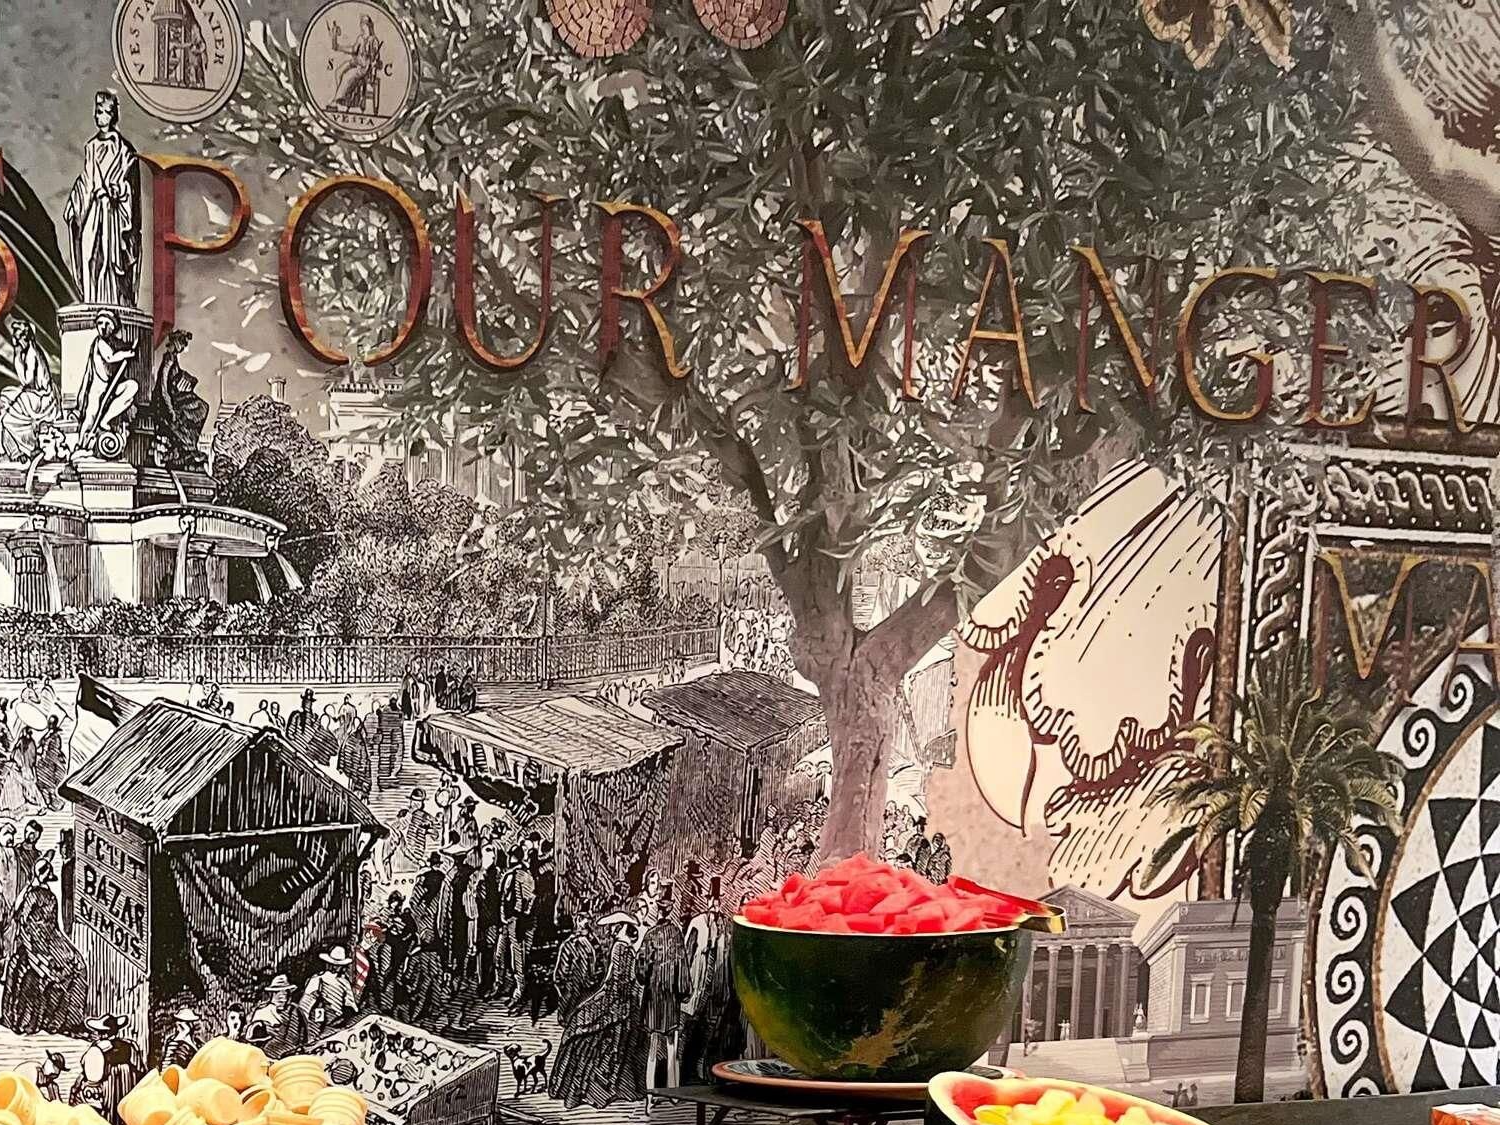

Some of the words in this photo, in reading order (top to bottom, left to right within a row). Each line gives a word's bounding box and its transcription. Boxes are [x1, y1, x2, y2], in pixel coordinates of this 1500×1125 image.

[331, 114, 375, 127] VESTA
[136, 153, 693, 380] POUR
[783, 218, 1486, 437] MANGER
[94, 805, 125, 835] AU
[84, 828, 145, 881] PETIT
[83, 864, 145, 941] BAZAR
